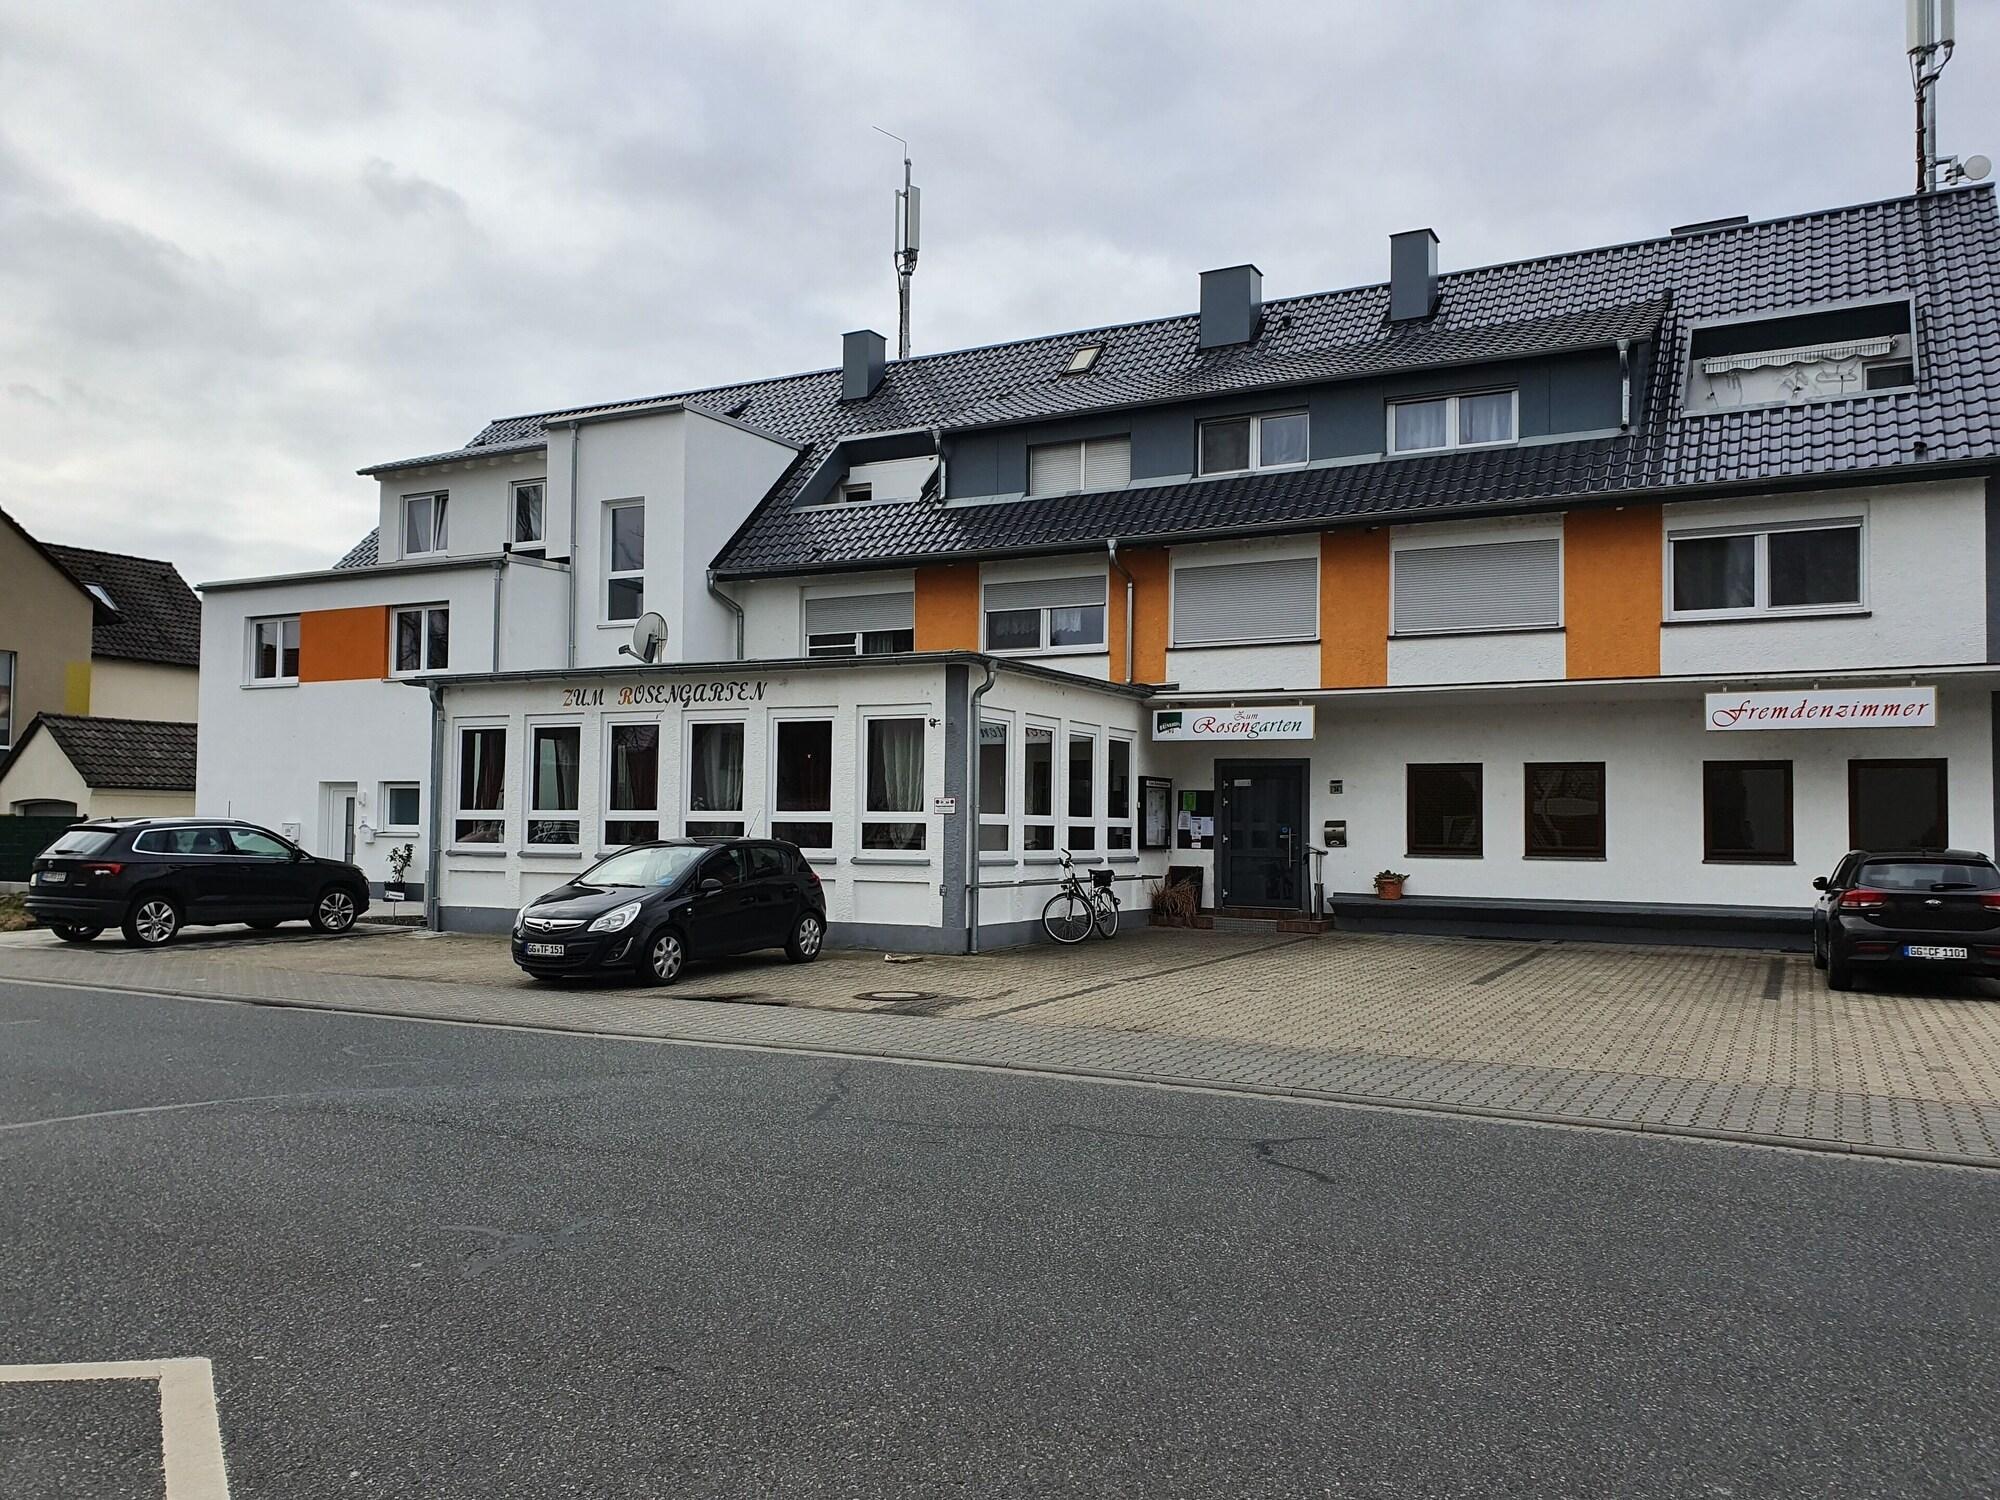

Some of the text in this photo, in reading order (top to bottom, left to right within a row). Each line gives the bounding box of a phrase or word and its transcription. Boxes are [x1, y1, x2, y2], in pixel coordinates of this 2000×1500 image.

[562, 681, 768, 708] ZUM ROSENGARTEN
[1234, 711, 1259, 721] Zum
[1712, 699, 1929, 727] Fremdenzimmer
[1193, 716, 1302, 739] Rosengarten
[550, 945, 563, 954] 151
[1928, 947, 1940, 956] CF
[1942, 948, 1966, 958] 1101
